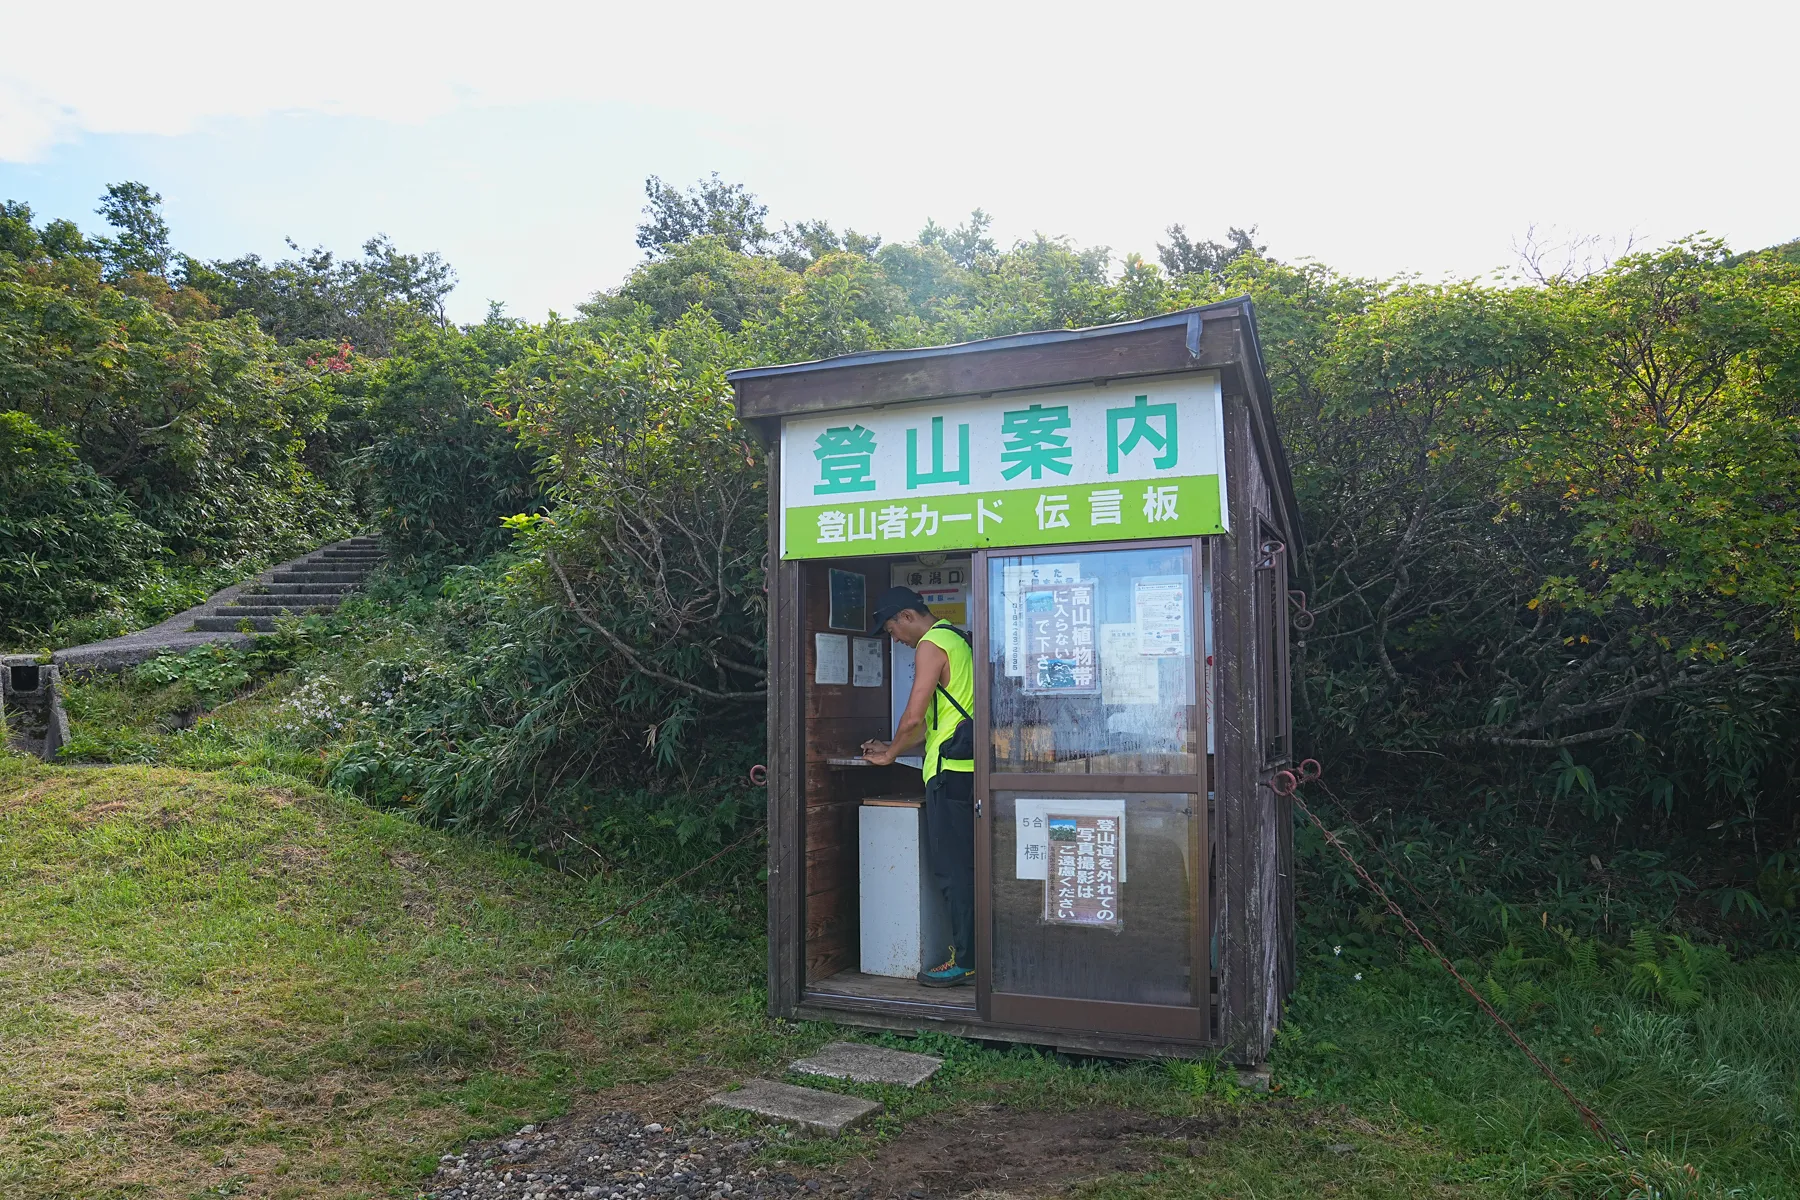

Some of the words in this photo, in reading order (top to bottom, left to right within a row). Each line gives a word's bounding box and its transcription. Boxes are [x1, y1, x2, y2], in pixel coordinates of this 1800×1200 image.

[813, 395, 1179, 495] 登山案内
[816, 498, 1004, 544] 登山者カード
[1035, 485, 1179, 530] 伝言板
[1035, 619, 1051, 687] で下さい
[1053, 589, 1070, 660] に入らない
[1070, 586, 1092, 686] 高山植物帯
[1057, 845, 1076, 919] ご遠慮ください
[1076, 827, 1095, 898] 写真撮影は
[1096, 819, 1115, 921] 登山道を外れての
